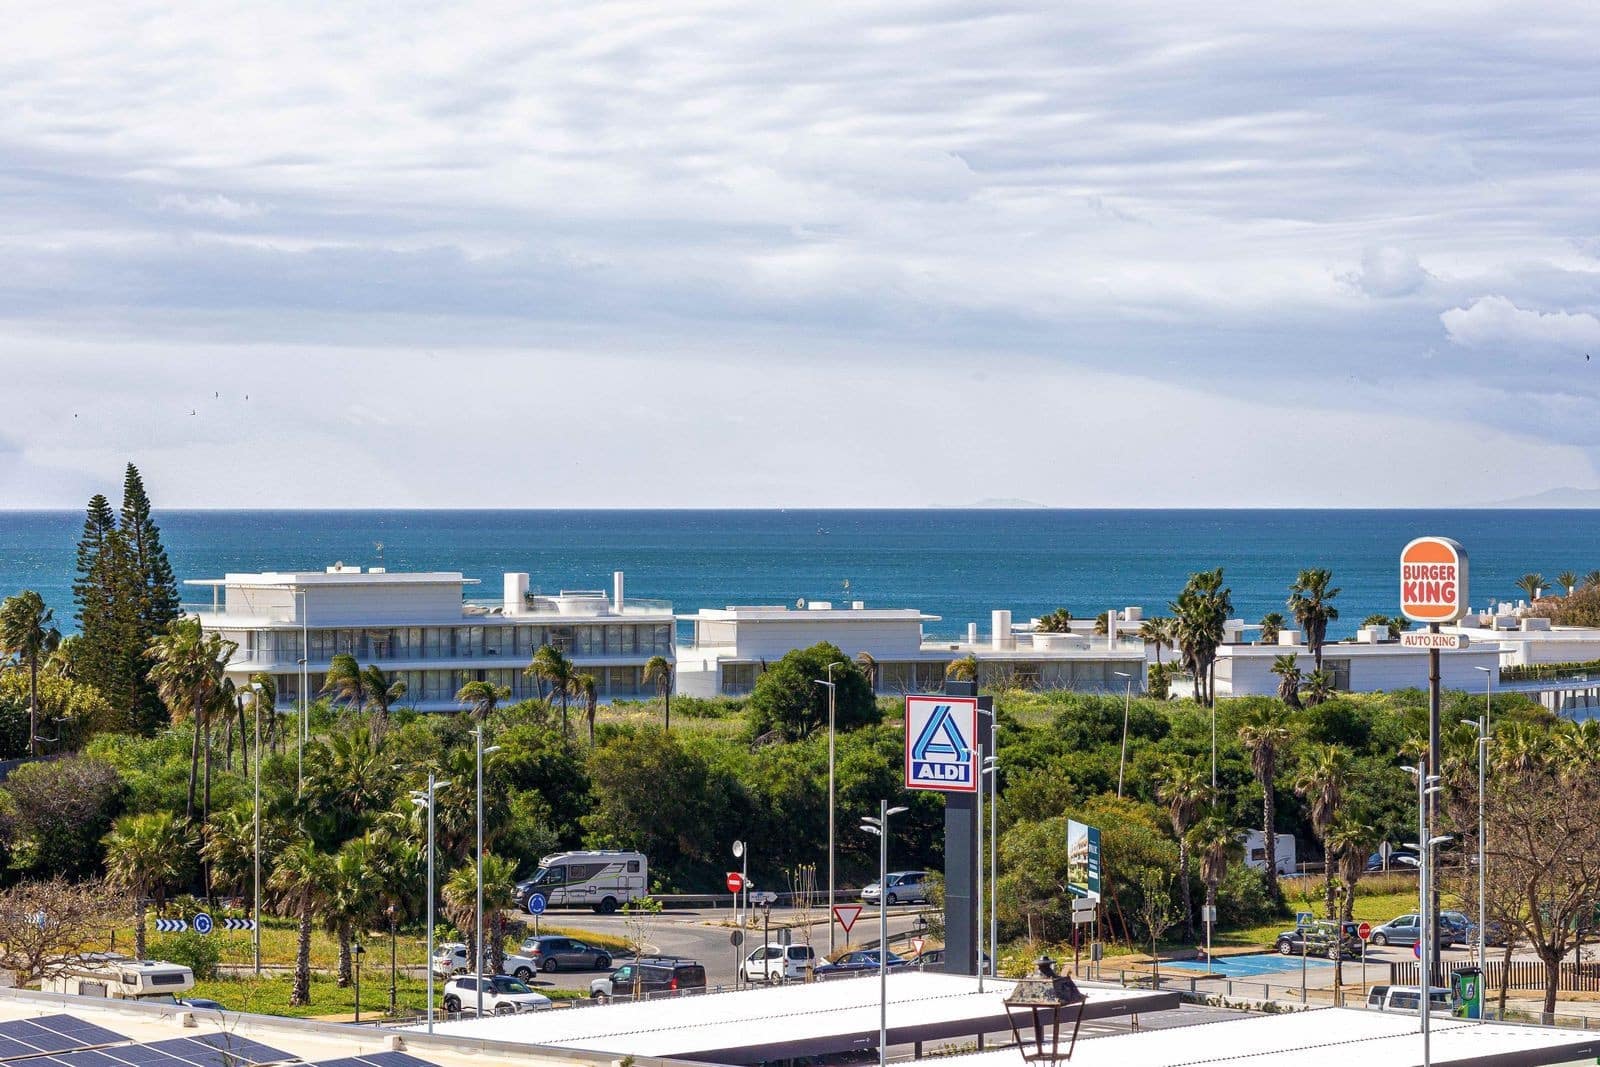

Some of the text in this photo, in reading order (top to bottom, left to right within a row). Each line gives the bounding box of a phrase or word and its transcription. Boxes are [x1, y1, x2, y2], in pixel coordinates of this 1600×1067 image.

[1403, 565, 1456, 580] BURGER
[1403, 581, 1456, 603] KING
[1404, 635, 1456, 647] AUTO KING
[918, 763, 965, 780] ALDI
